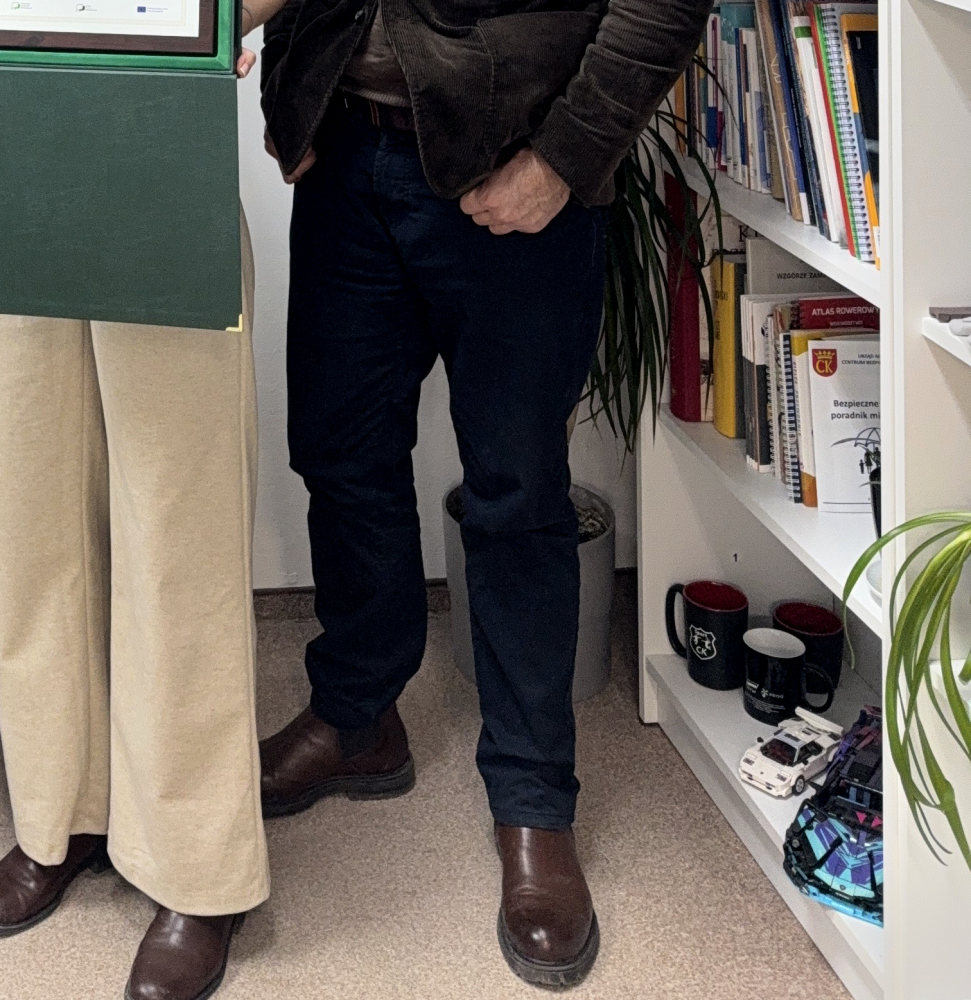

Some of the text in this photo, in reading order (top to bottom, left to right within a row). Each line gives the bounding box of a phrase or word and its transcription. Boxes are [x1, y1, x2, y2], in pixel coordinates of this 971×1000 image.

[811, 308, 835, 316] ATLAS
[815, 359, 833, 374] CK
[833, 400, 880, 409] Bezpieczne
[830, 411, 868, 420] poradnik
